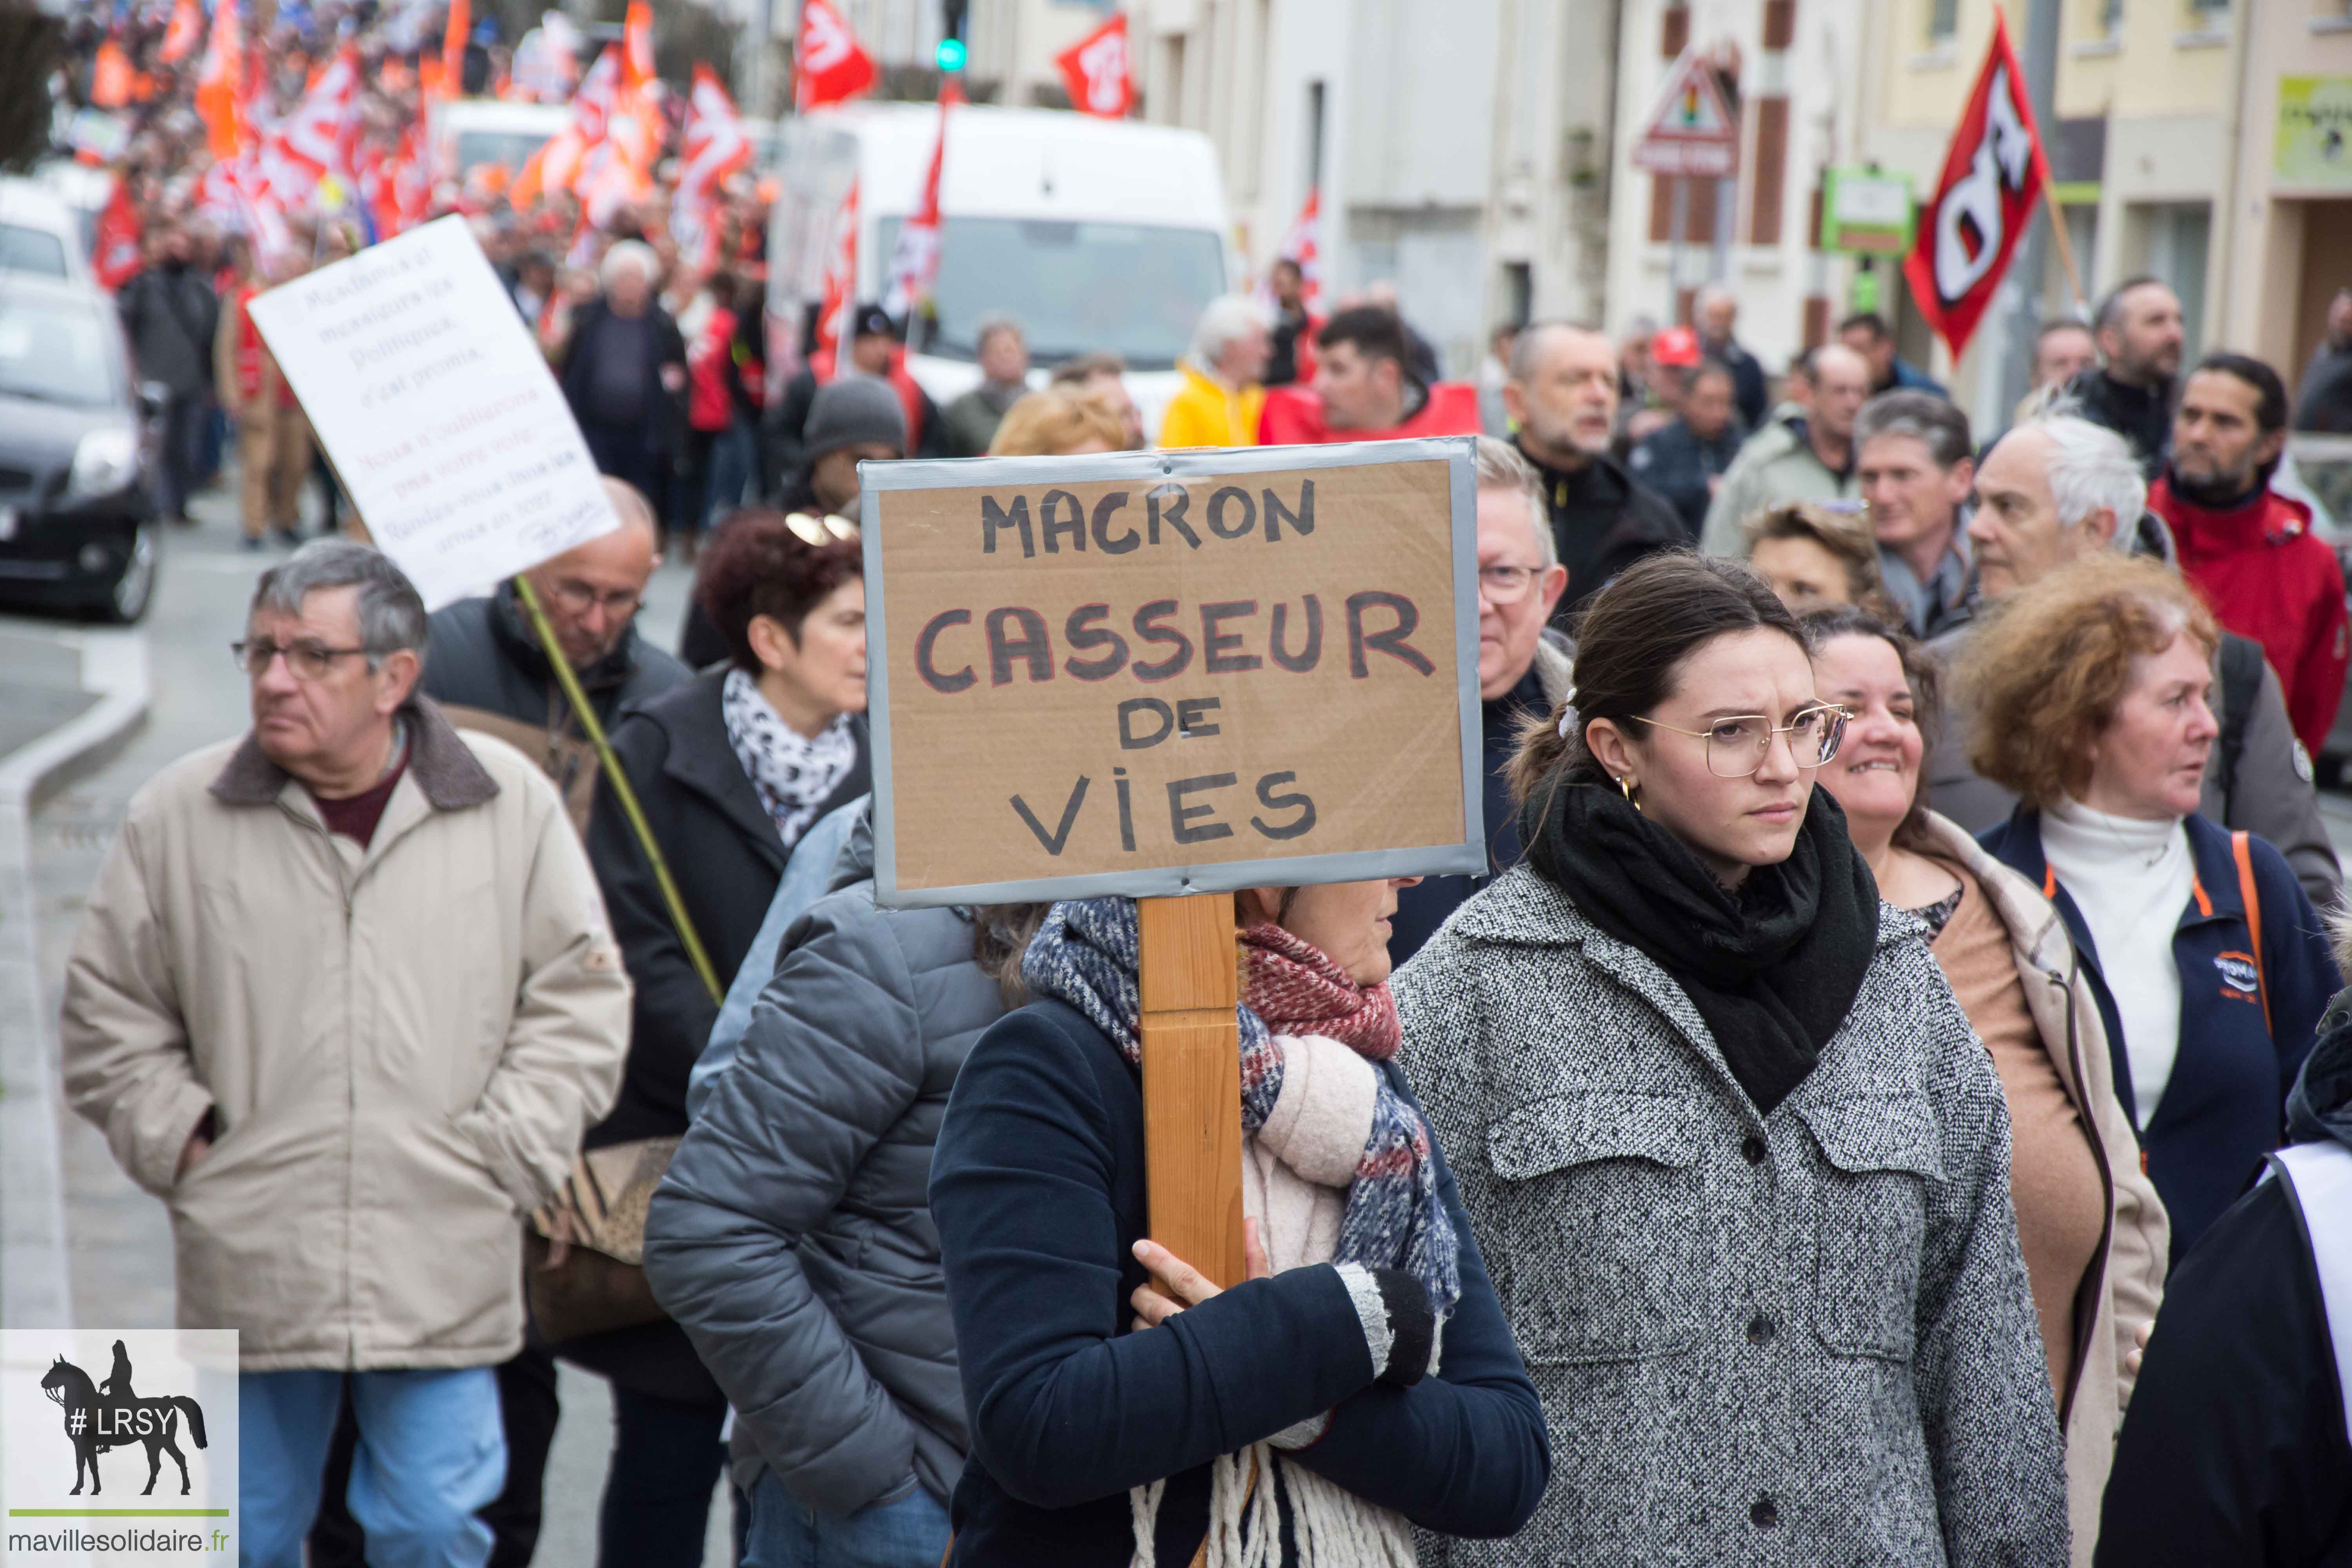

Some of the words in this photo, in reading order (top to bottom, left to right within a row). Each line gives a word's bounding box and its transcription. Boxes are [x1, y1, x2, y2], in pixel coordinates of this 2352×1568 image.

[981, 479, 1315, 558] MACRON
[914, 591, 1437, 694] CASSEUR
[1118, 697, 1220, 750] DE
